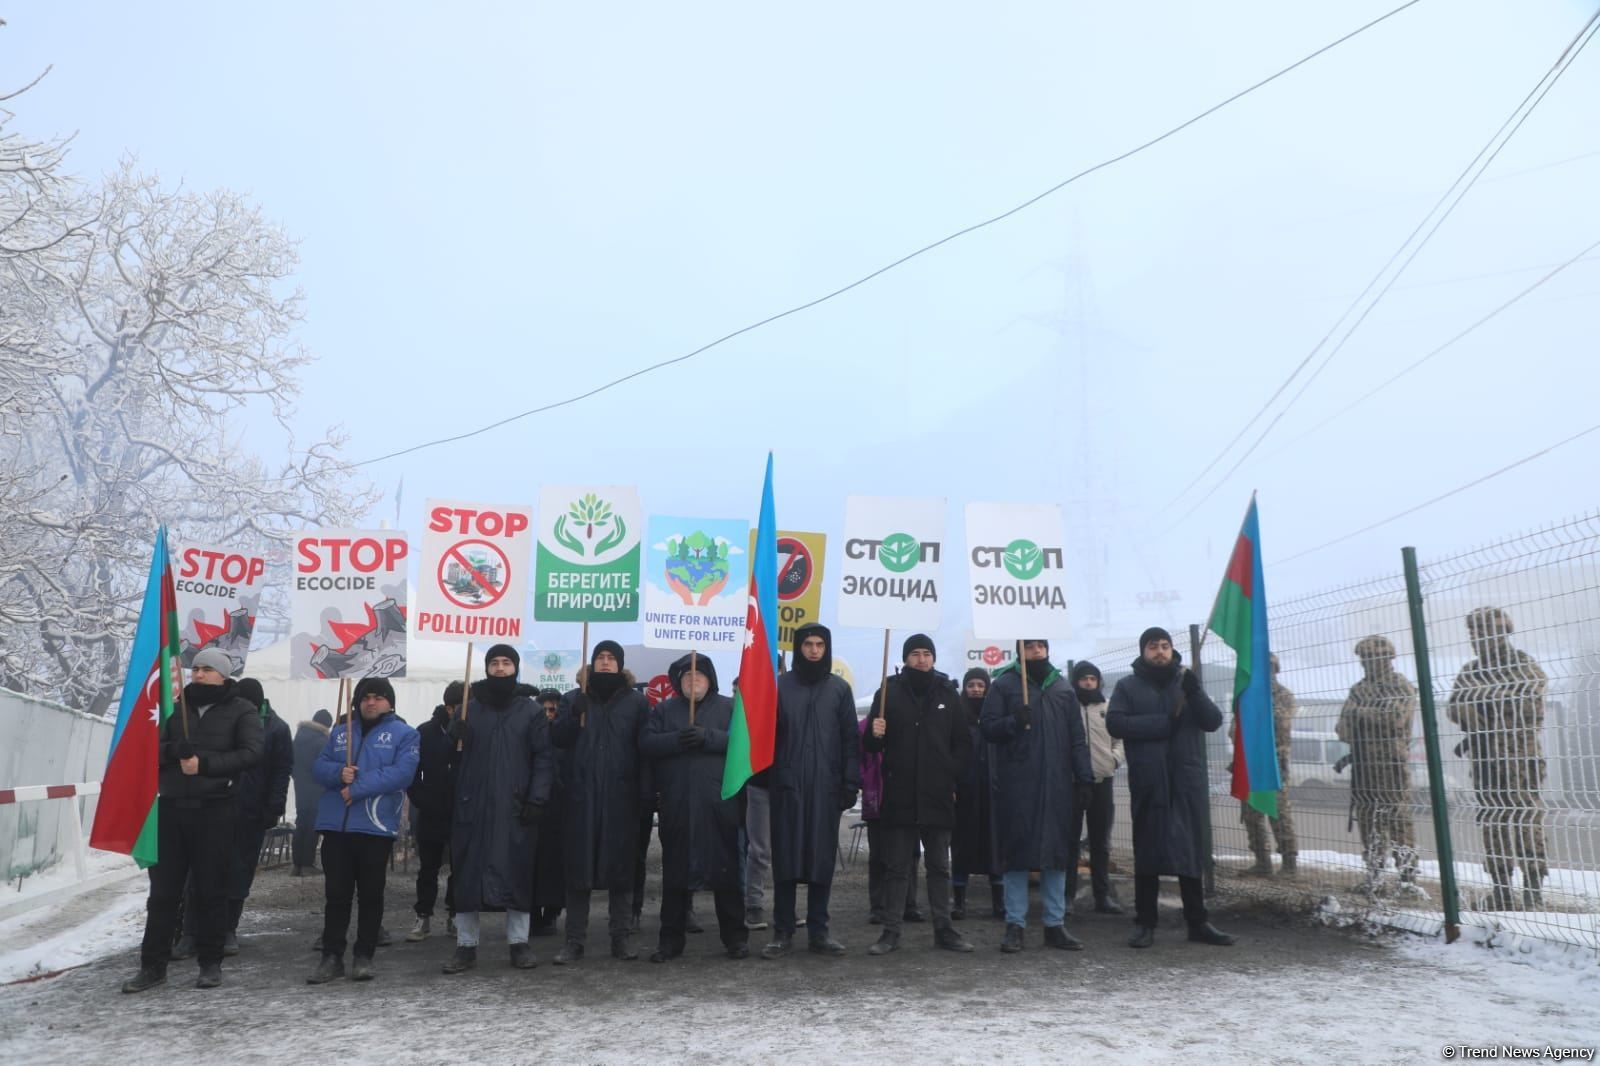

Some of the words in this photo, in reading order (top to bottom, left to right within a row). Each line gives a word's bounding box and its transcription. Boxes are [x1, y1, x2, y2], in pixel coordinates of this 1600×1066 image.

[429, 507, 528, 537] STOP
[297, 538, 407, 573] STOP
[180, 548, 264, 586] STOP
[176, 579, 236, 599] ECOCIDE
[297, 576, 375, 591] ECOCIDE
[548, 572, 631, 589] БЕРЕГИТЕ
[842, 575, 938, 603] ЭКОЦИД
[547, 592, 631, 612] ПРИРОДУ!
[975, 584, 1066, 609] ЭКОЦИД
[418, 612, 520, 637] POLLUTION
[645, 612, 677, 625] UNITE
[679, 614, 701, 626] FOR
[703, 615, 745, 627] NATURE
[654, 629, 686, 641] UNITE
[688, 630, 710, 641] FOR
[712, 631, 735, 642] LIFE
[540, 674, 565, 682] SAVE
